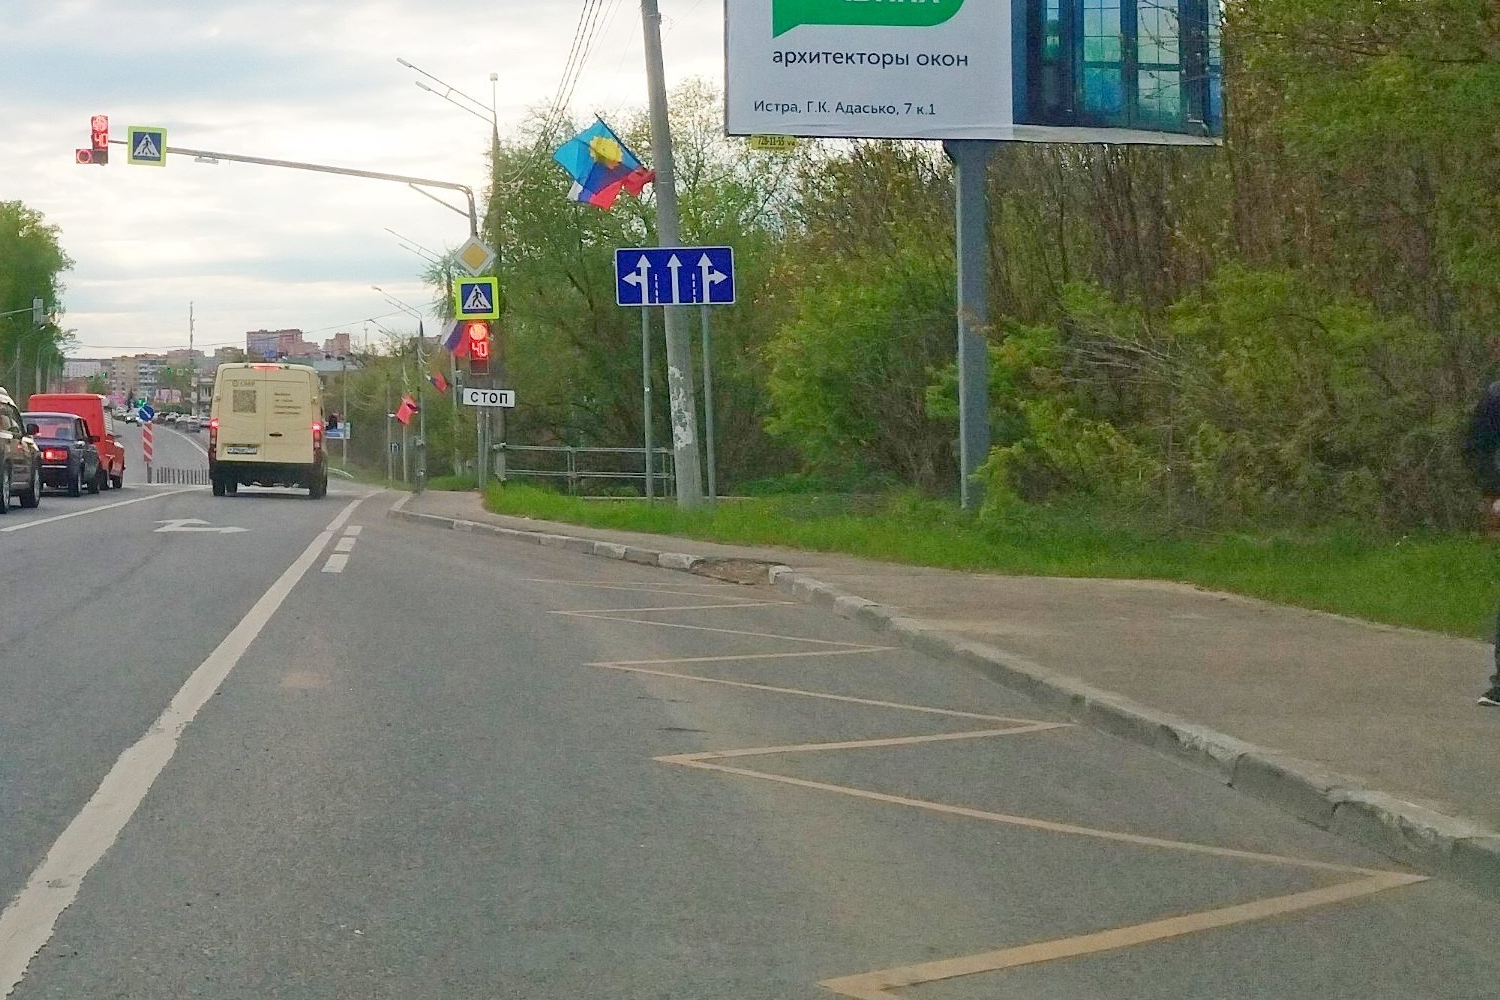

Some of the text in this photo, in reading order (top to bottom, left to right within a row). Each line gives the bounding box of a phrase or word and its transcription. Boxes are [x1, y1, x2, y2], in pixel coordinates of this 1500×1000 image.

[772, 50, 969, 69] архитекторы окон
[753, 100, 802, 115] Истра,
[806, 100, 831, 114] Г.К.
[835, 102, 900, 116] Адасько,
[904, 102, 913, 115] 7
[471, 341, 488, 357] 40
[470, 391, 508, 404] СТОП
